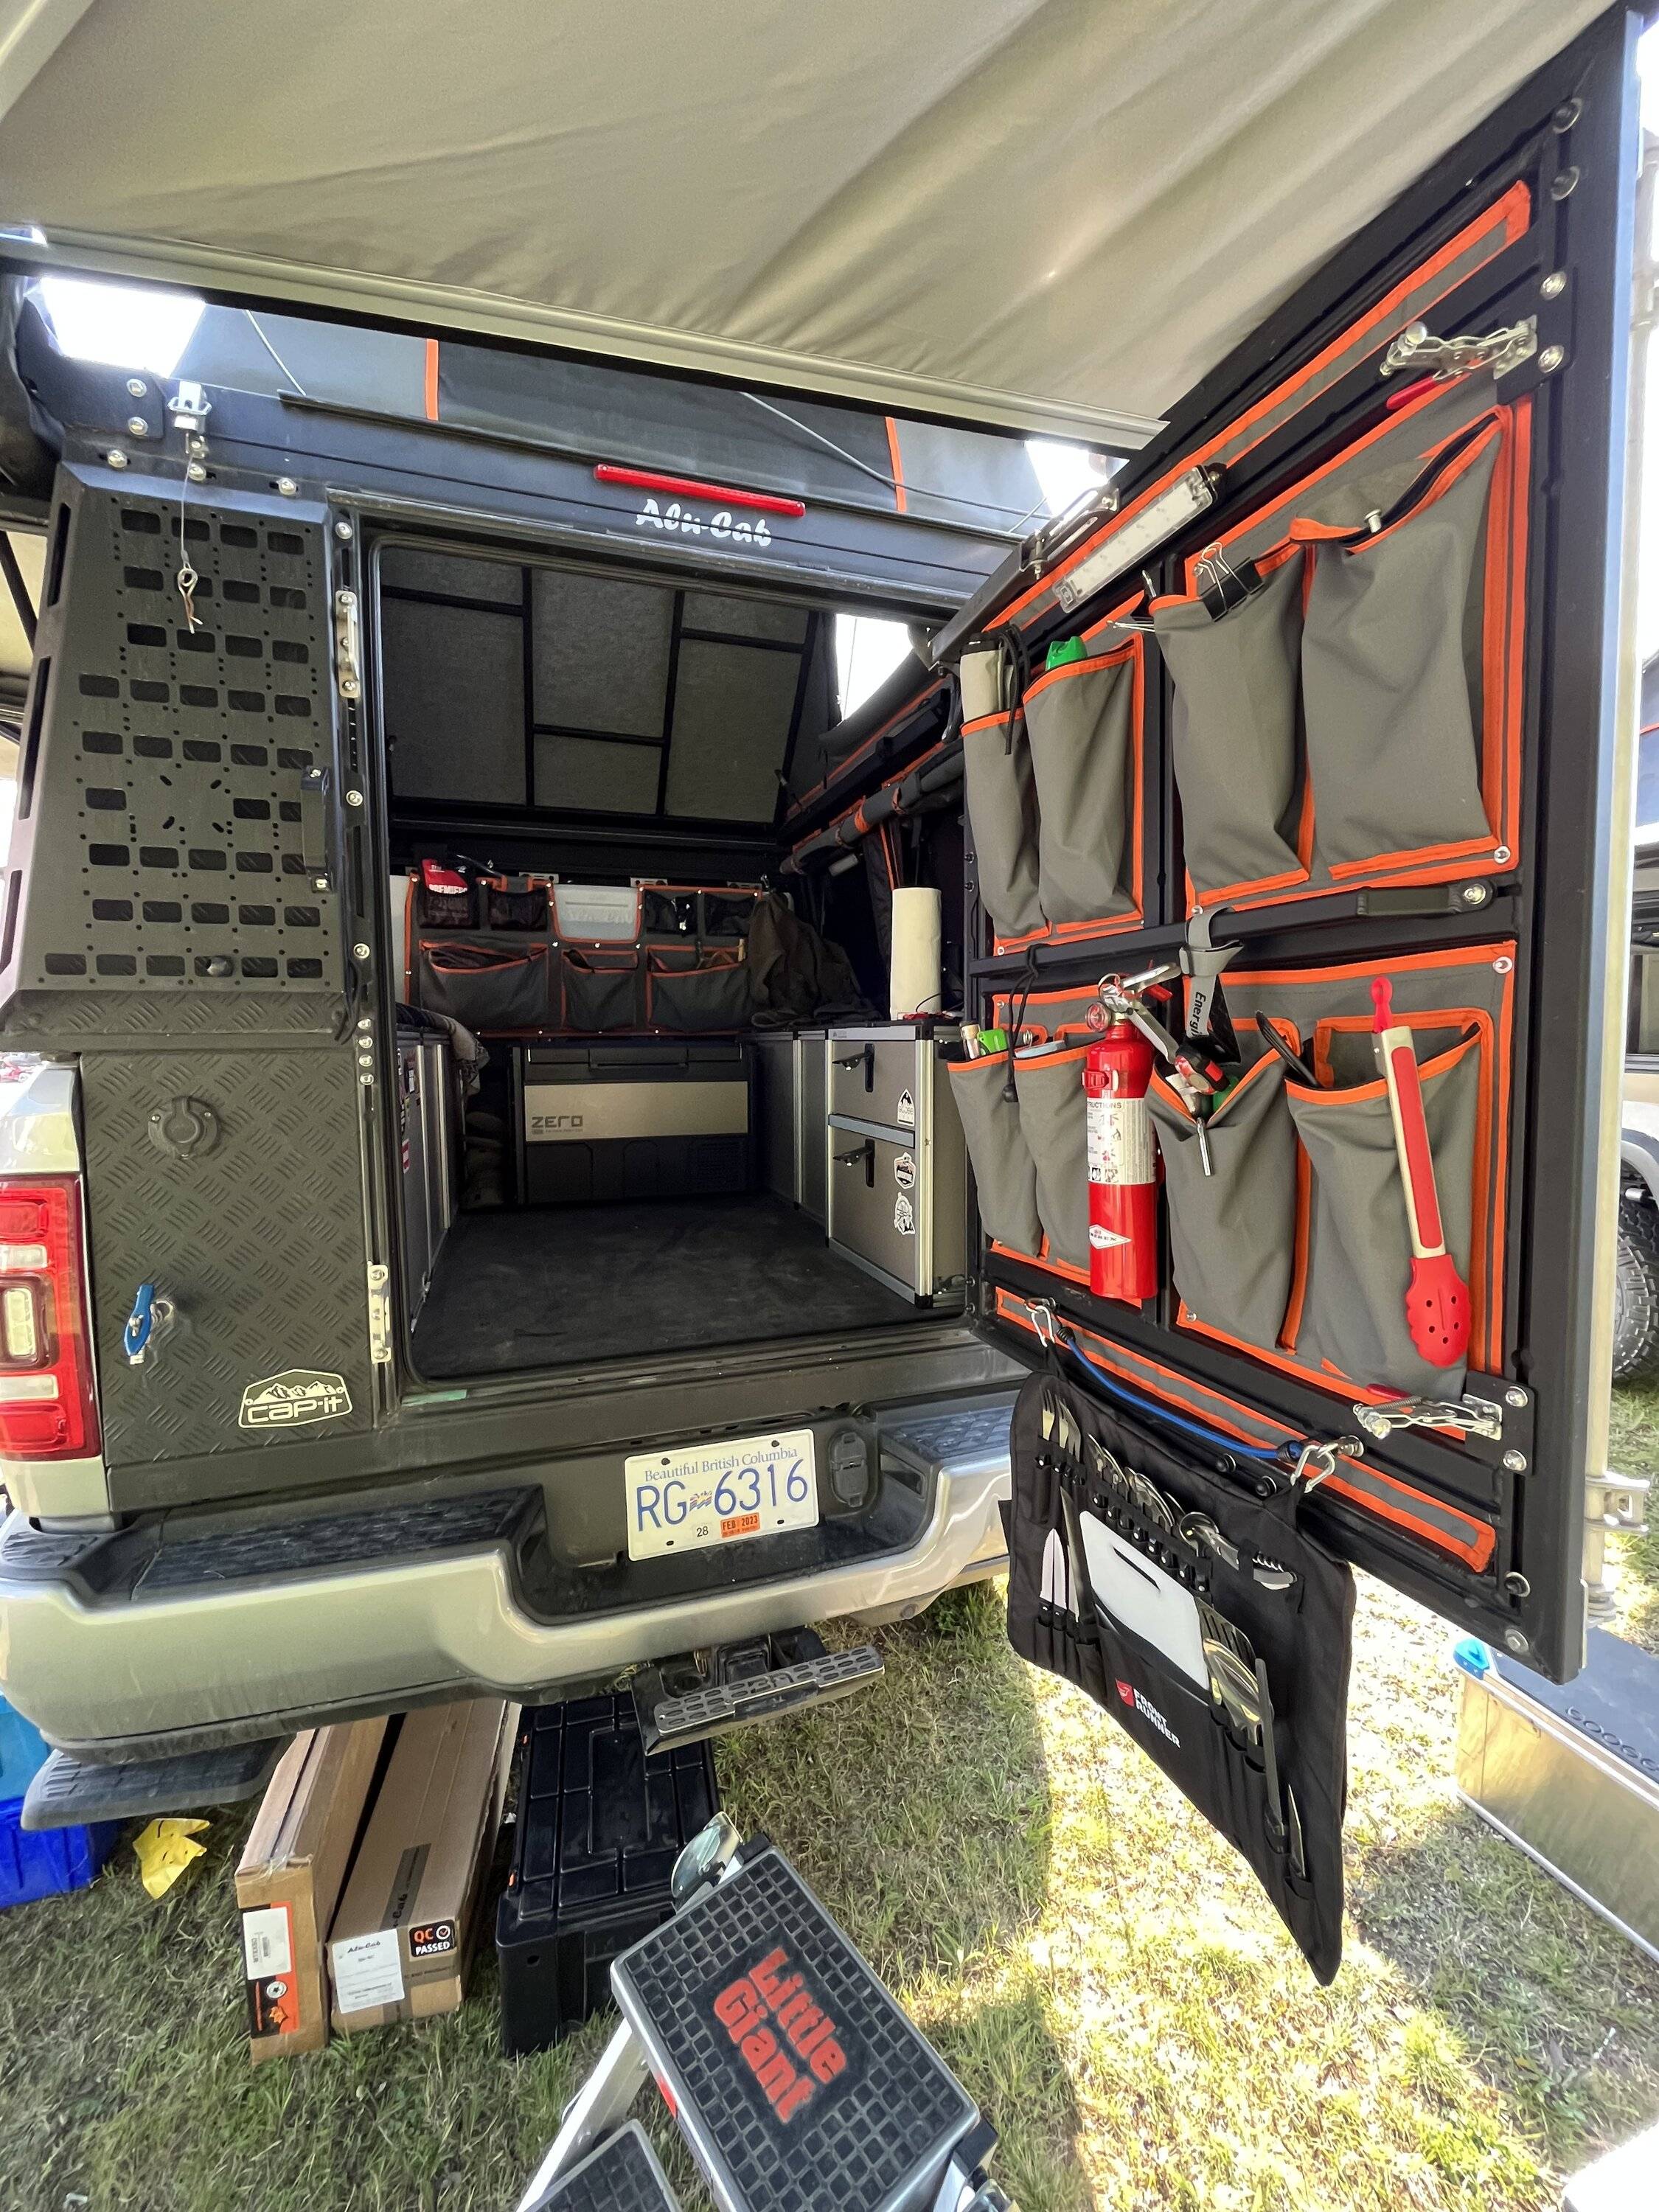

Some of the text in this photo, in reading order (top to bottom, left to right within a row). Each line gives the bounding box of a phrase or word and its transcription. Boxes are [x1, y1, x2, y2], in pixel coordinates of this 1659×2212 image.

[636, 498, 772, 547] Alu-Cab
[1189, 991, 1206, 1036] Energi
[644, 1447, 798, 1482] Beautiful British Columbia
[636, 1458, 808, 1532] RG 6316
[696, 1526, 709, 1537] 28
[723, 1520, 736, 1531] FEB
[742, 1514, 758, 1526] 2023
[1133, 1688, 1167, 1727] FRONT
[1135, 1699, 1180, 1748] RUNNER
[414, 1927, 434, 1944] QC
[415, 1941, 451, 1955] PASSED
[748, 1946, 846, 2084] Little
[714, 1978, 816, 2124] Giant
